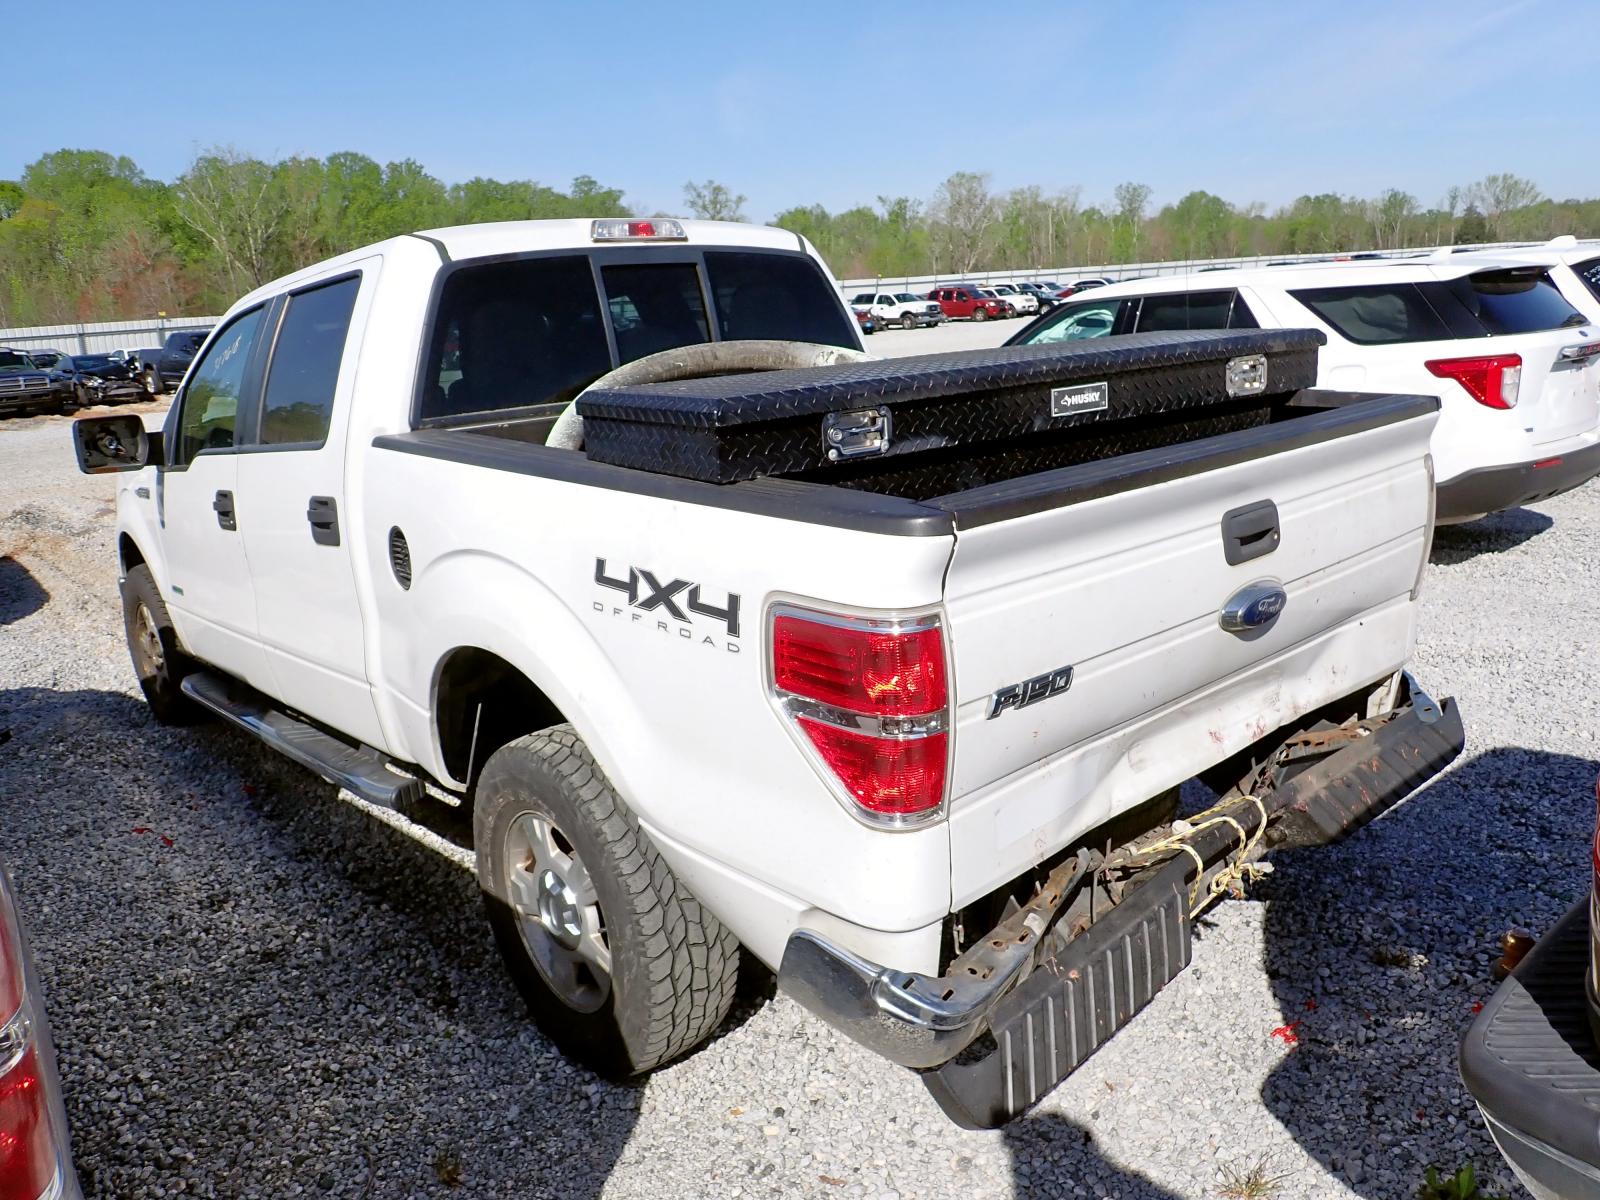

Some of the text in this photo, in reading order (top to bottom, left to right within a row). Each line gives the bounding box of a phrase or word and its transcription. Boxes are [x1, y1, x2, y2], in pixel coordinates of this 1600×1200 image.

[1071, 391, 1100, 405] HUSKY
[593, 601, 740, 653] OFFROAD
[984, 664, 1074, 720] F-150
